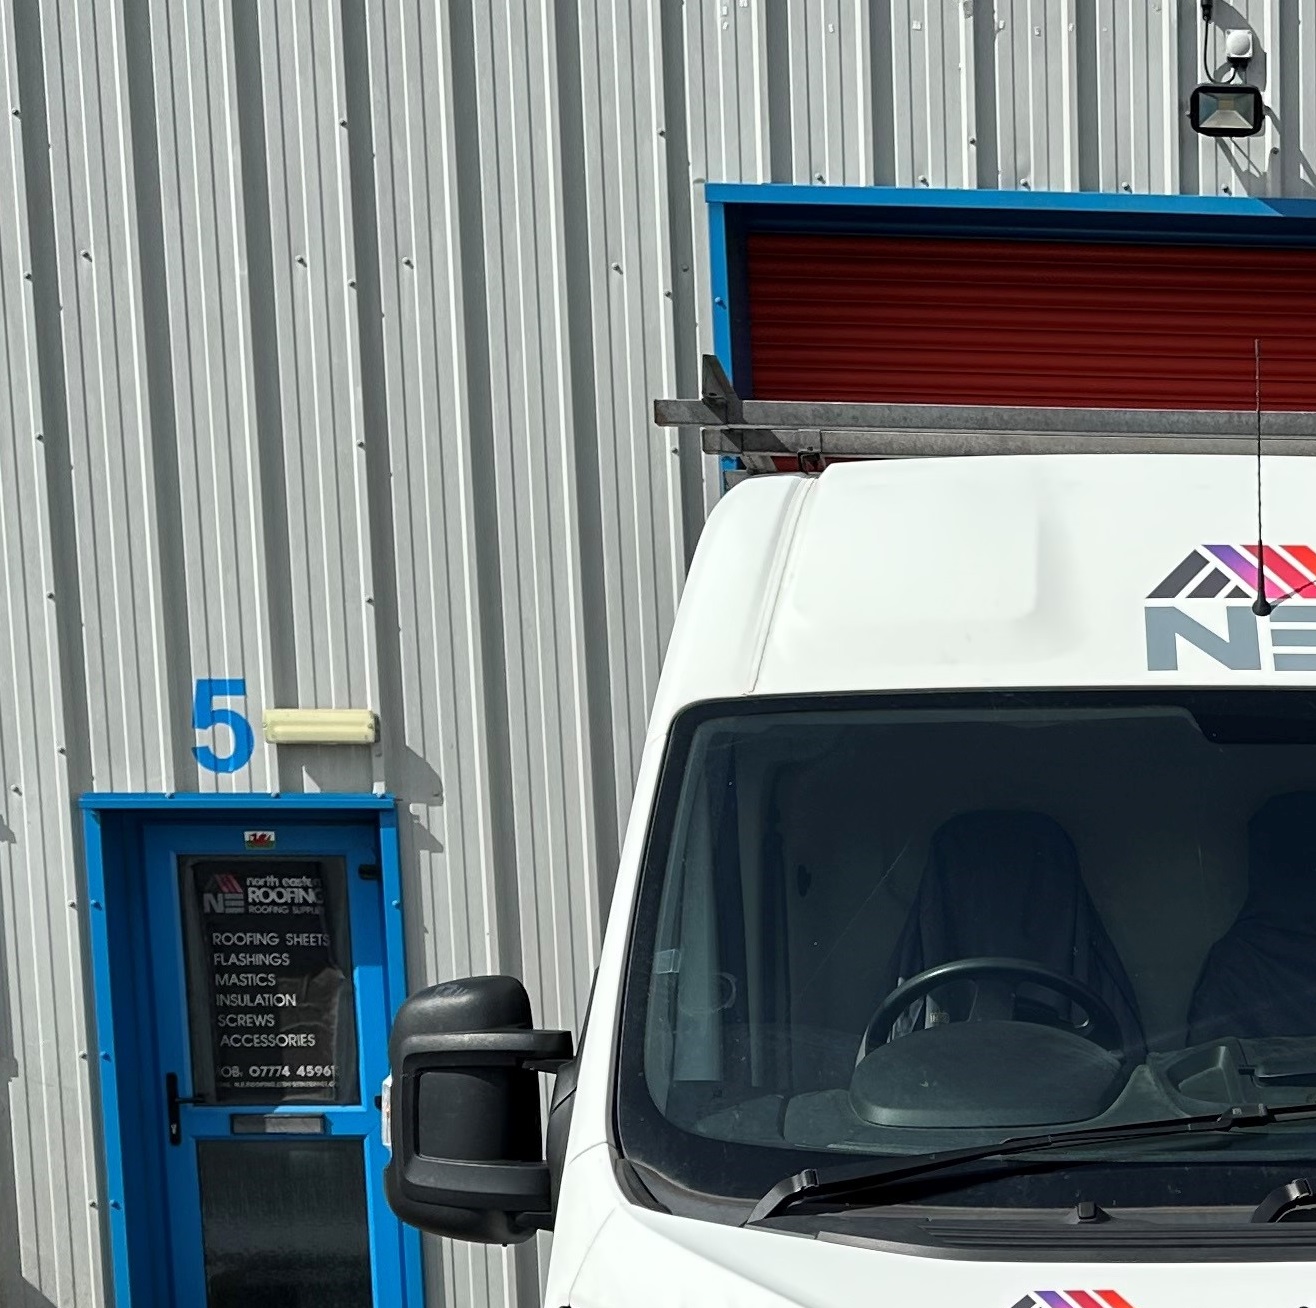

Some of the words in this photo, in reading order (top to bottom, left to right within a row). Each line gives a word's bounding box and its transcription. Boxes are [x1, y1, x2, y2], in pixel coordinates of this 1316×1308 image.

[191, 678, 255, 773] 5
[246, 875, 279, 886] north
[203, 893, 245, 913] NE
[248, 905, 289, 914] ROOFING
[212, 932, 280, 946] ROOFING
[285, 933, 330, 946] SHEETS
[214, 953, 290, 966] FLASHINGS
[215, 973, 276, 987] MASTICS
[216, 993, 297, 1007] INSULATION
[217, 1014, 275, 1027] SCREWS
[220, 1034, 316, 1047] ACCESSORIES
[249, 1065, 291, 1077] 07774
